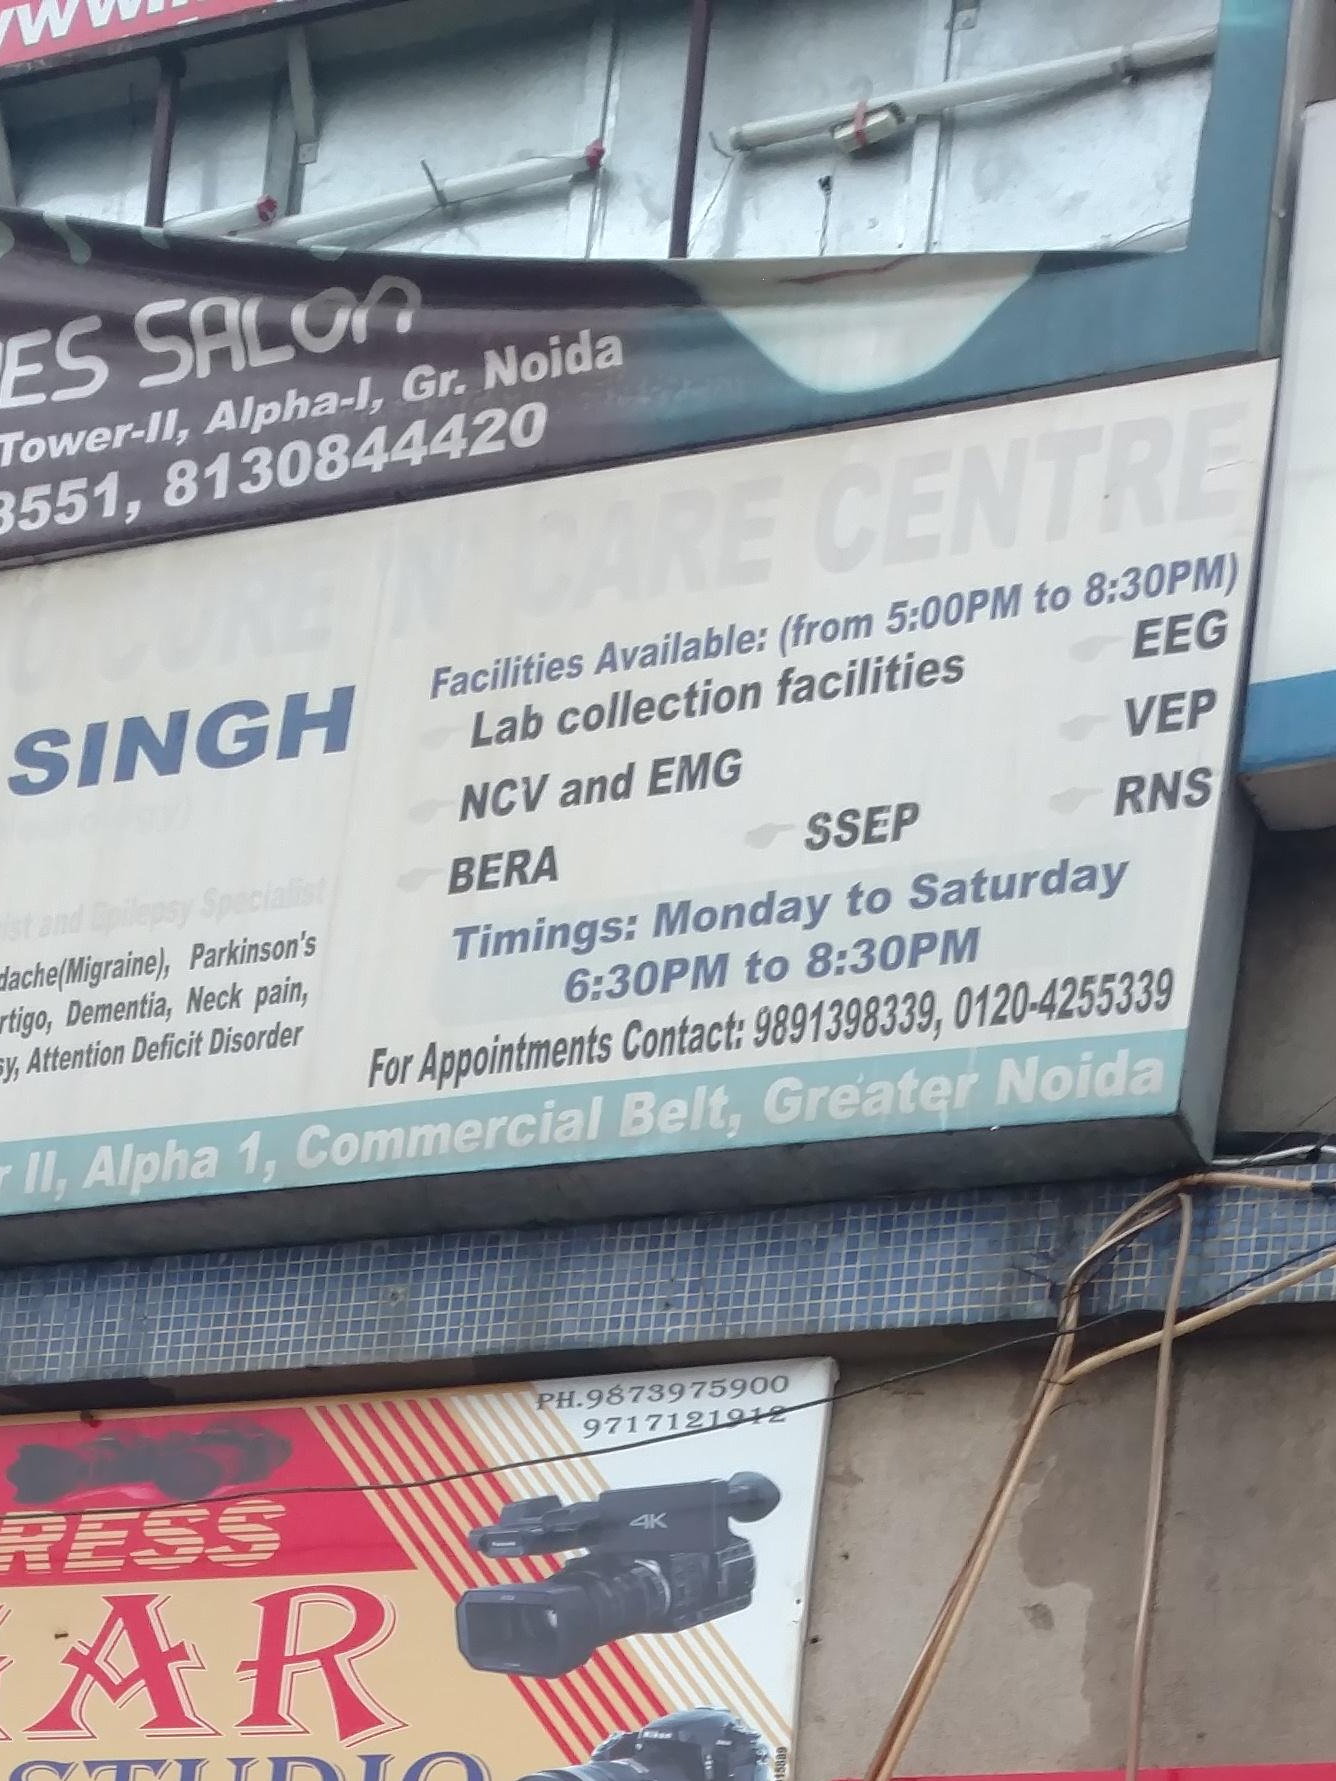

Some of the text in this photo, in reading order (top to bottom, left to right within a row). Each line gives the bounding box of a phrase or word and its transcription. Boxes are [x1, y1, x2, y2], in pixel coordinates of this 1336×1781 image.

[401, 364, 467, 403] Gr.
[483, 328, 624, 391] Noida
[163, 400, 549, 507] 8130844420
[430, 551, 1240, 700] Facilities Available: (from 5:00PM to 8:30PM)
[1132, 609, 1229, 660] EEG
[470, 652, 965, 749] Lab collection facilities
[1124, 688, 1218, 738] VEP
[7, 685, 357, 796] SINGH
[458, 748, 744, 822] NCV and EMG
[1113, 766, 1213, 817] RNS
[804, 801, 921, 852] SSEP
[447, 845, 559, 895] BERA
[452, 858, 1131, 961] Timings: Monday to Saturday
[189, 930, 317, 970] Parkinson's
[563, 927, 982, 1003] 6:30PM to 8:30PM
[368, 967, 1175, 1091] For Appointments Contact: 9891398339, 0120-4255339
[81, 1138, 221, 1196] Alpha
[239, 1130, 277, 1184] 1,
[295, 1094, 604, 1170] Commercial
[619, 1083, 743, 1141] Belt,
[763, 1067, 981, 1125] Greater
[995, 1048, 1165, 1105] Noida
